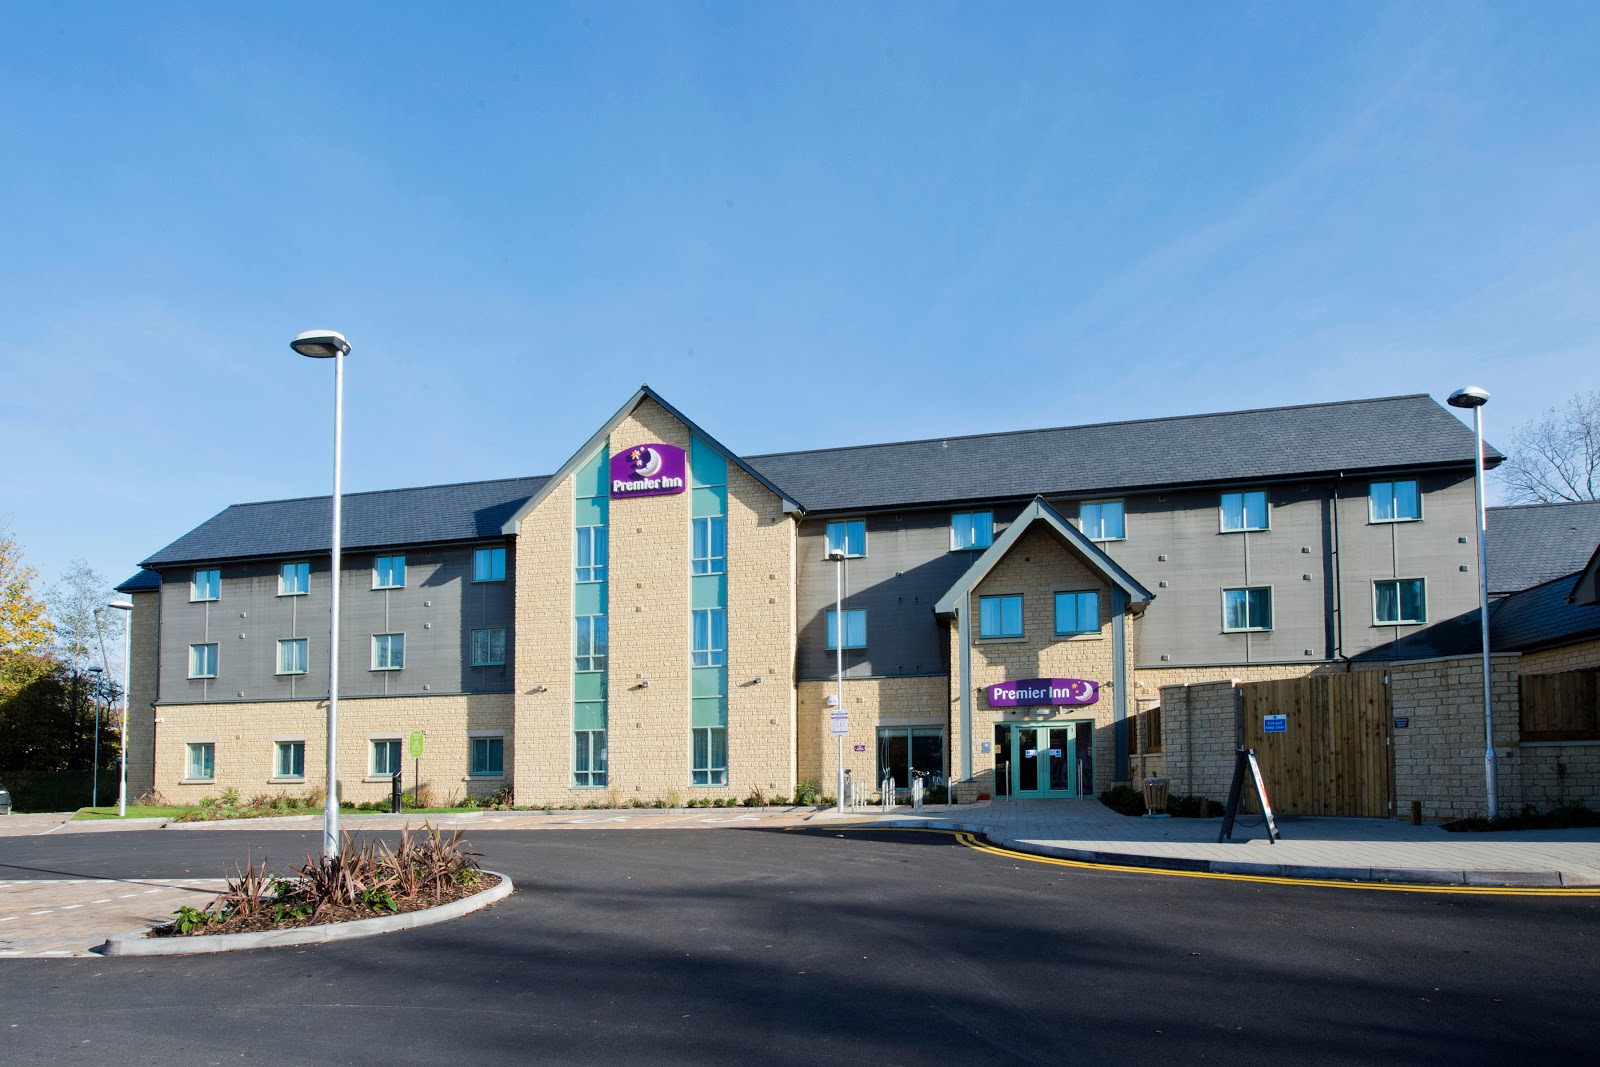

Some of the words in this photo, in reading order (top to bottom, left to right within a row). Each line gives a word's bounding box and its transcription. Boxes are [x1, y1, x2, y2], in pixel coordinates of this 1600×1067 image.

[613, 478, 661, 492] Premier
[662, 476, 682, 487] Inn
[993, 687, 1046, 700] Premier
[1048, 686, 1070, 698] Inn
